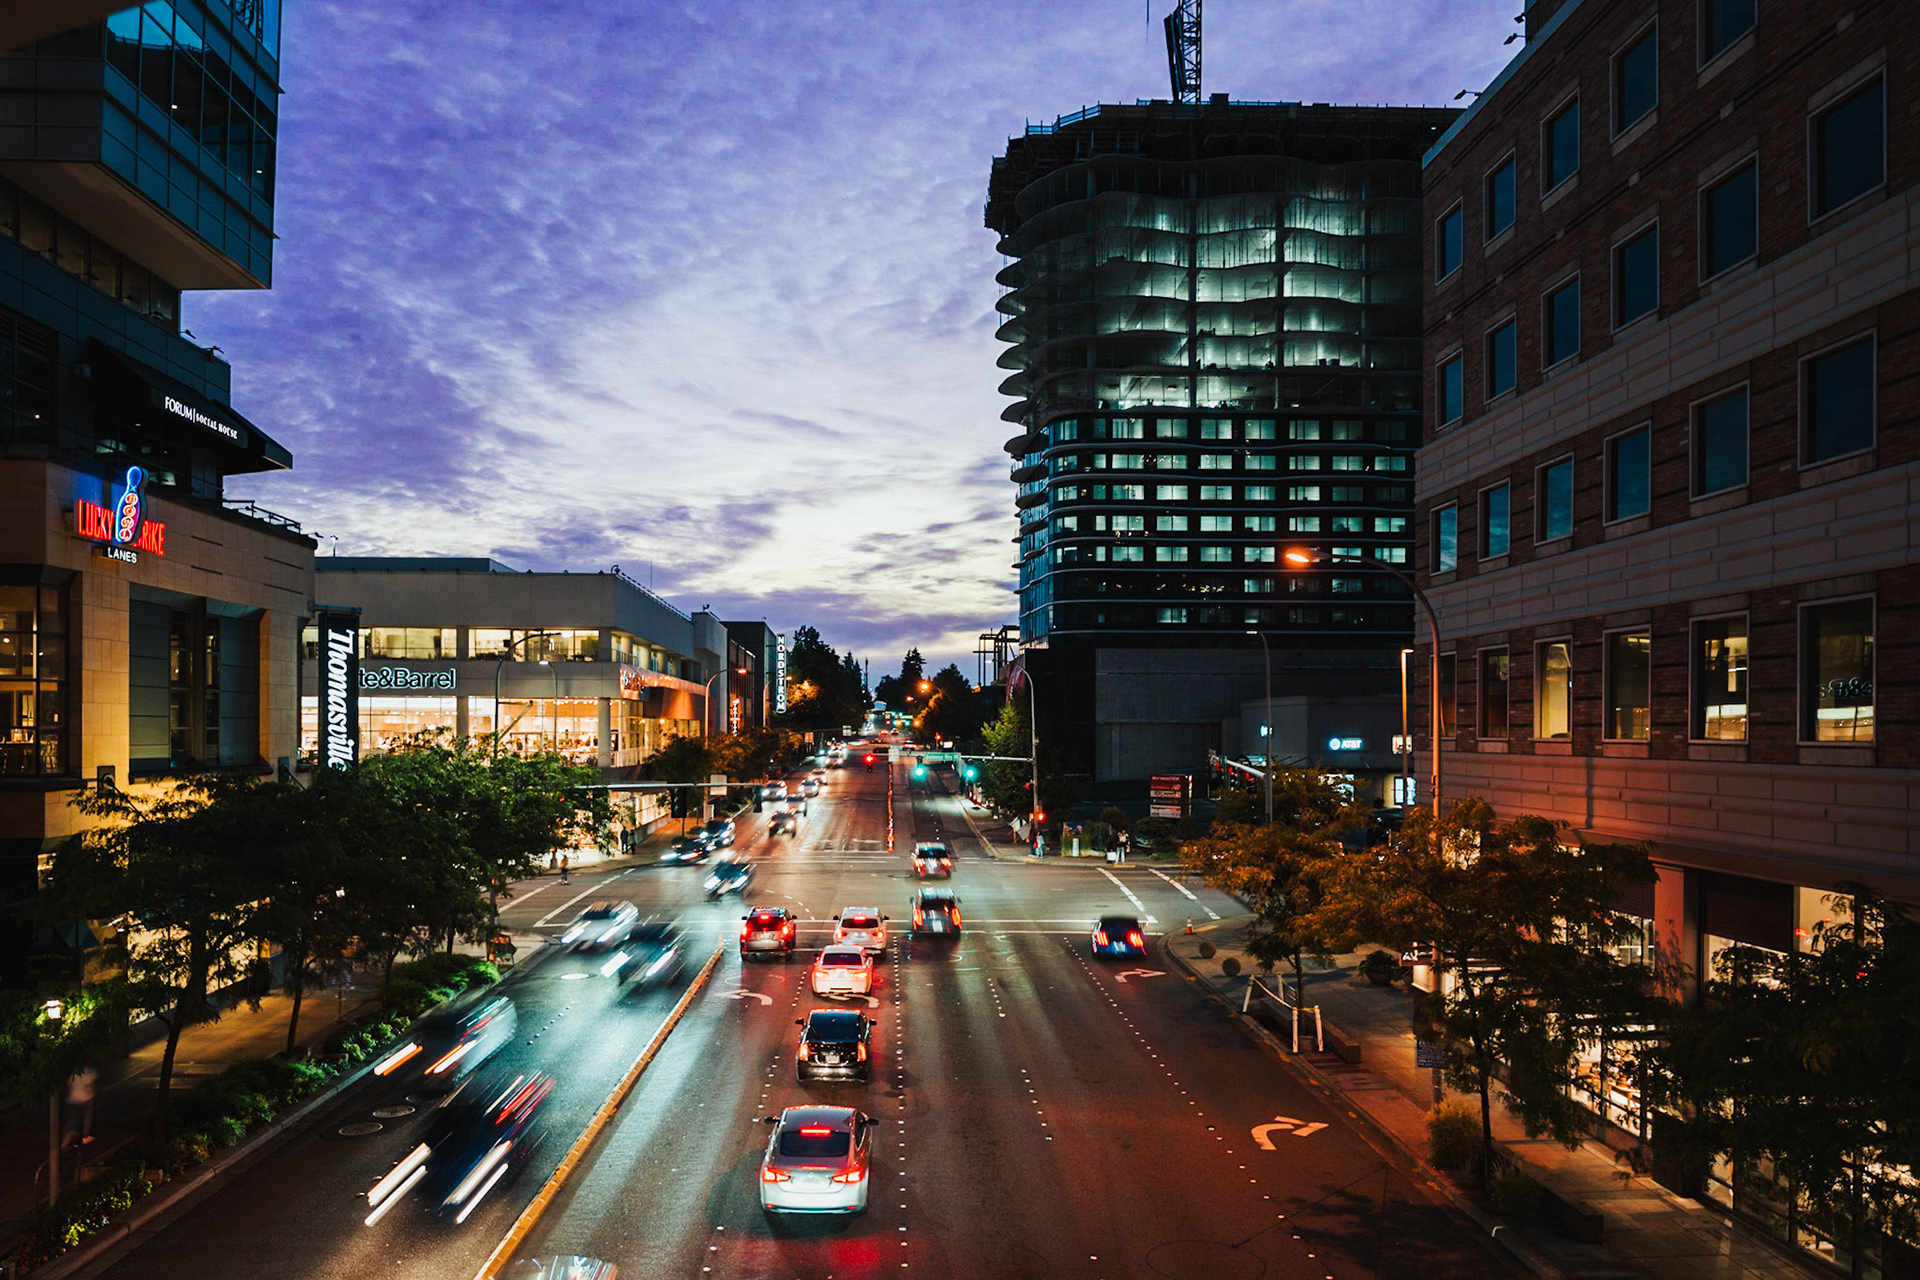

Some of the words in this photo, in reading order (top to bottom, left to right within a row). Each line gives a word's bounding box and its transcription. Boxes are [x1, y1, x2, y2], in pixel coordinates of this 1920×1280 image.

[165, 396, 193, 421] FORUM
[218, 423, 238, 440] HOUSE
[78, 498, 115, 541] LUCKY
[133, 520, 166, 556] RIKE
[107, 547, 138, 563] LANES
[776, 636, 786, 710] NORDSTROM
[327, 628, 355, 772] Thomasville
[1340, 739, 1363, 749] AT&T
